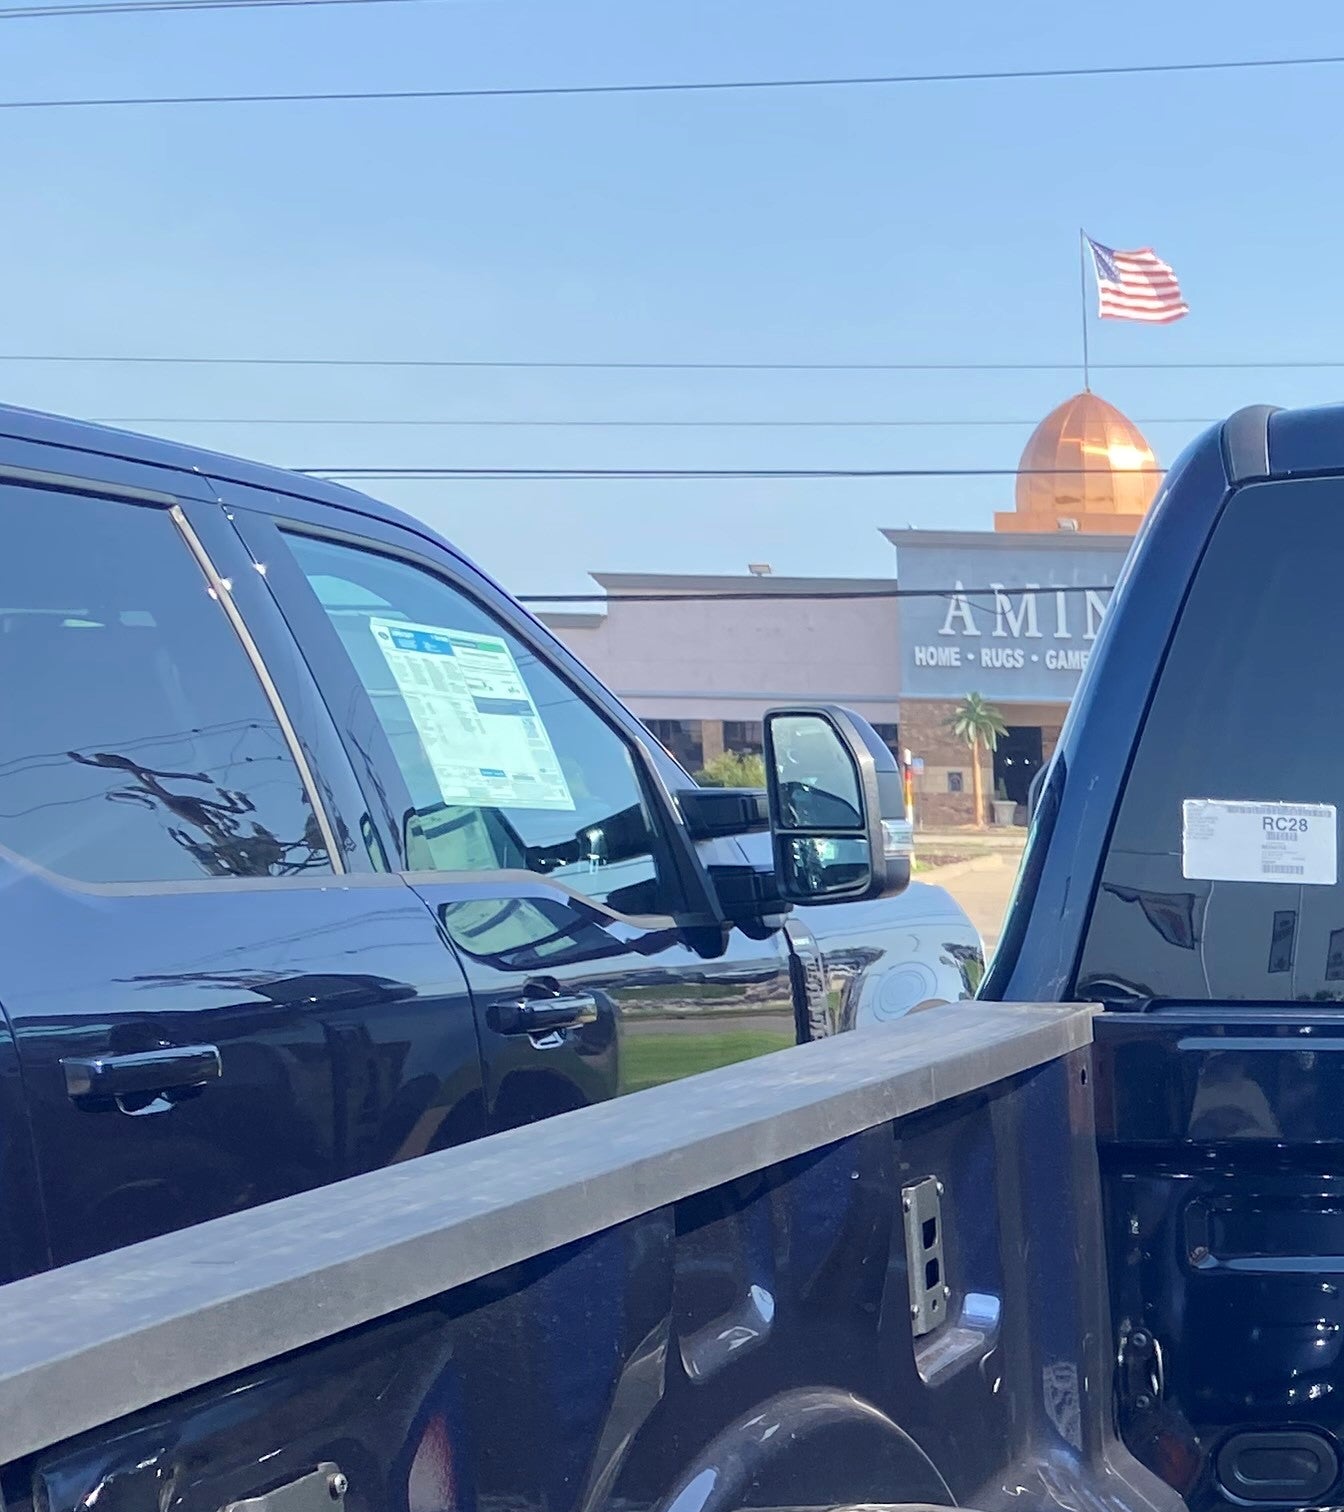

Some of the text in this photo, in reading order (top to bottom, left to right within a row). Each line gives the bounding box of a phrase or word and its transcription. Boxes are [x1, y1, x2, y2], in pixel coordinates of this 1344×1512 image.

[914, 646, 961, 667] HOME
[981, 648, 1025, 669] RUGS
[1262, 816, 1308, 832] RC28
